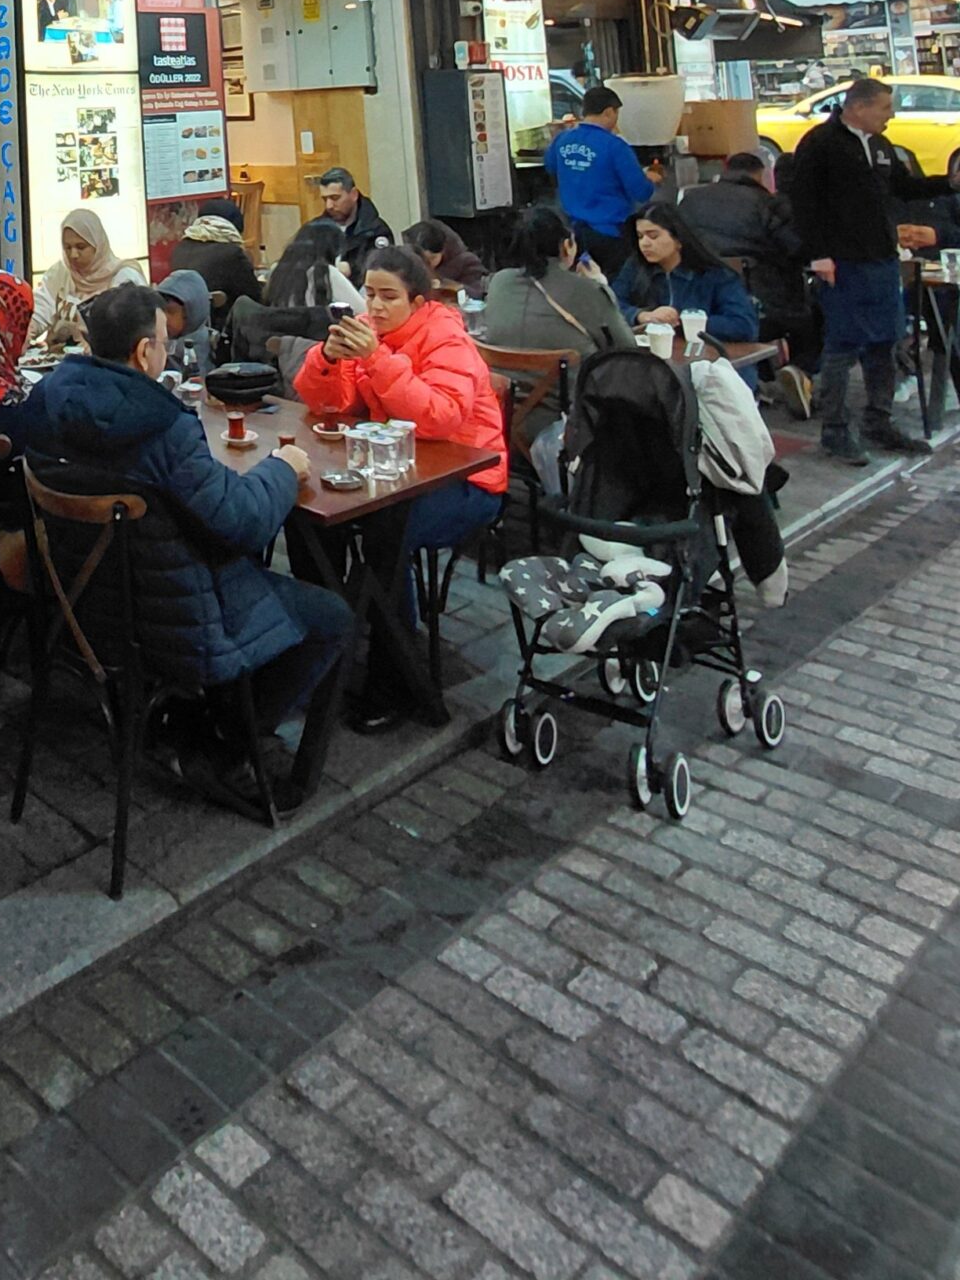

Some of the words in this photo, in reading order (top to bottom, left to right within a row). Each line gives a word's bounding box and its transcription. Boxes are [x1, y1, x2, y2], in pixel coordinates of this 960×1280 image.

[29, 83, 50, 97] The
[52, 83, 75, 96] New
[78, 83, 104, 97] York
[105, 82, 136, 96] Times
